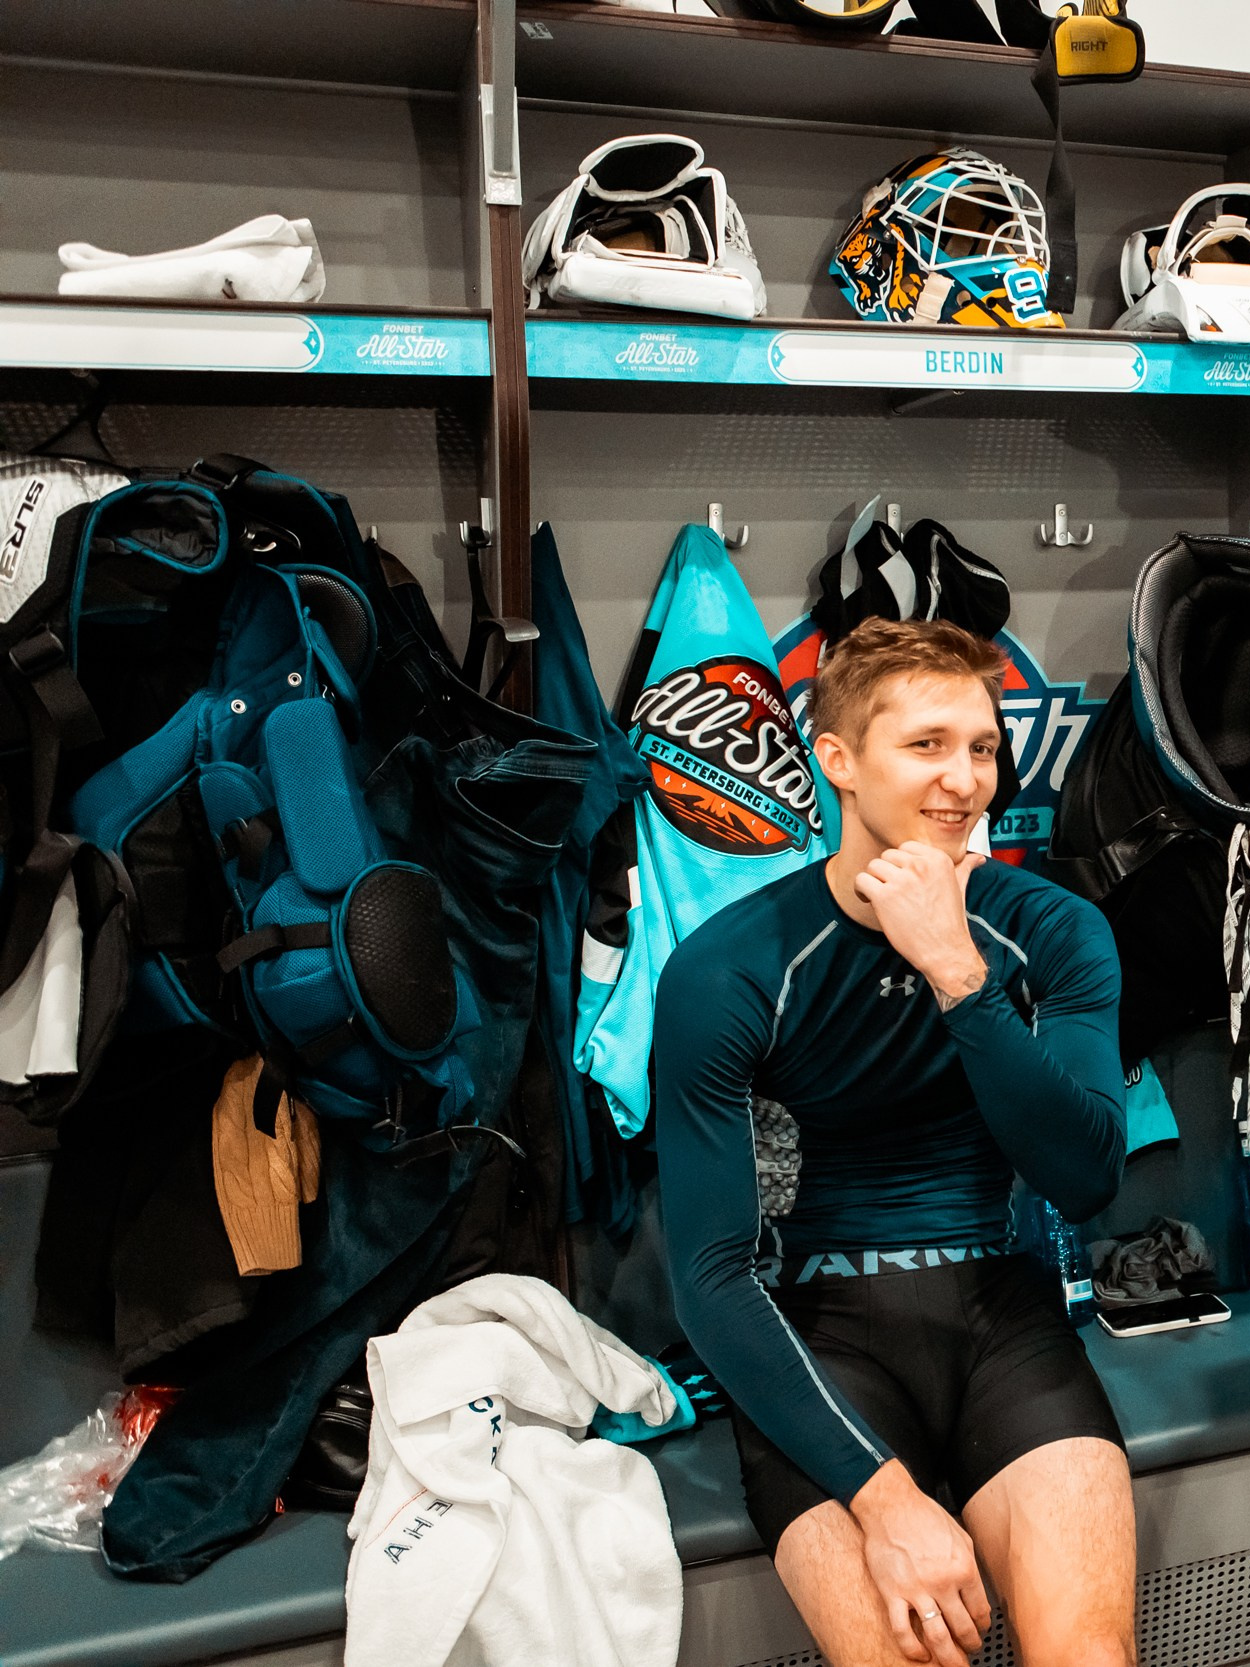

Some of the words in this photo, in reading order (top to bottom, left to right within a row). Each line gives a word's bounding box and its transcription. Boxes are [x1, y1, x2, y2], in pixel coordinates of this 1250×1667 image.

[1071, 41, 1108, 52] RIGHT
[1003, 267, 1050, 324] 9
[382, 324, 424, 334] FONBET
[640, 332, 678, 342] FONBET
[356, 334, 449, 359] All-Star
[615, 342, 700, 366] All-Star
[925, 350, 1003, 375] BERDIN
[732, 671, 795, 732] FONBET
[649, 740, 671, 761] ST.
[673, 751, 766, 811] PETERSBURG
[769, 803, 800, 834] 2023
